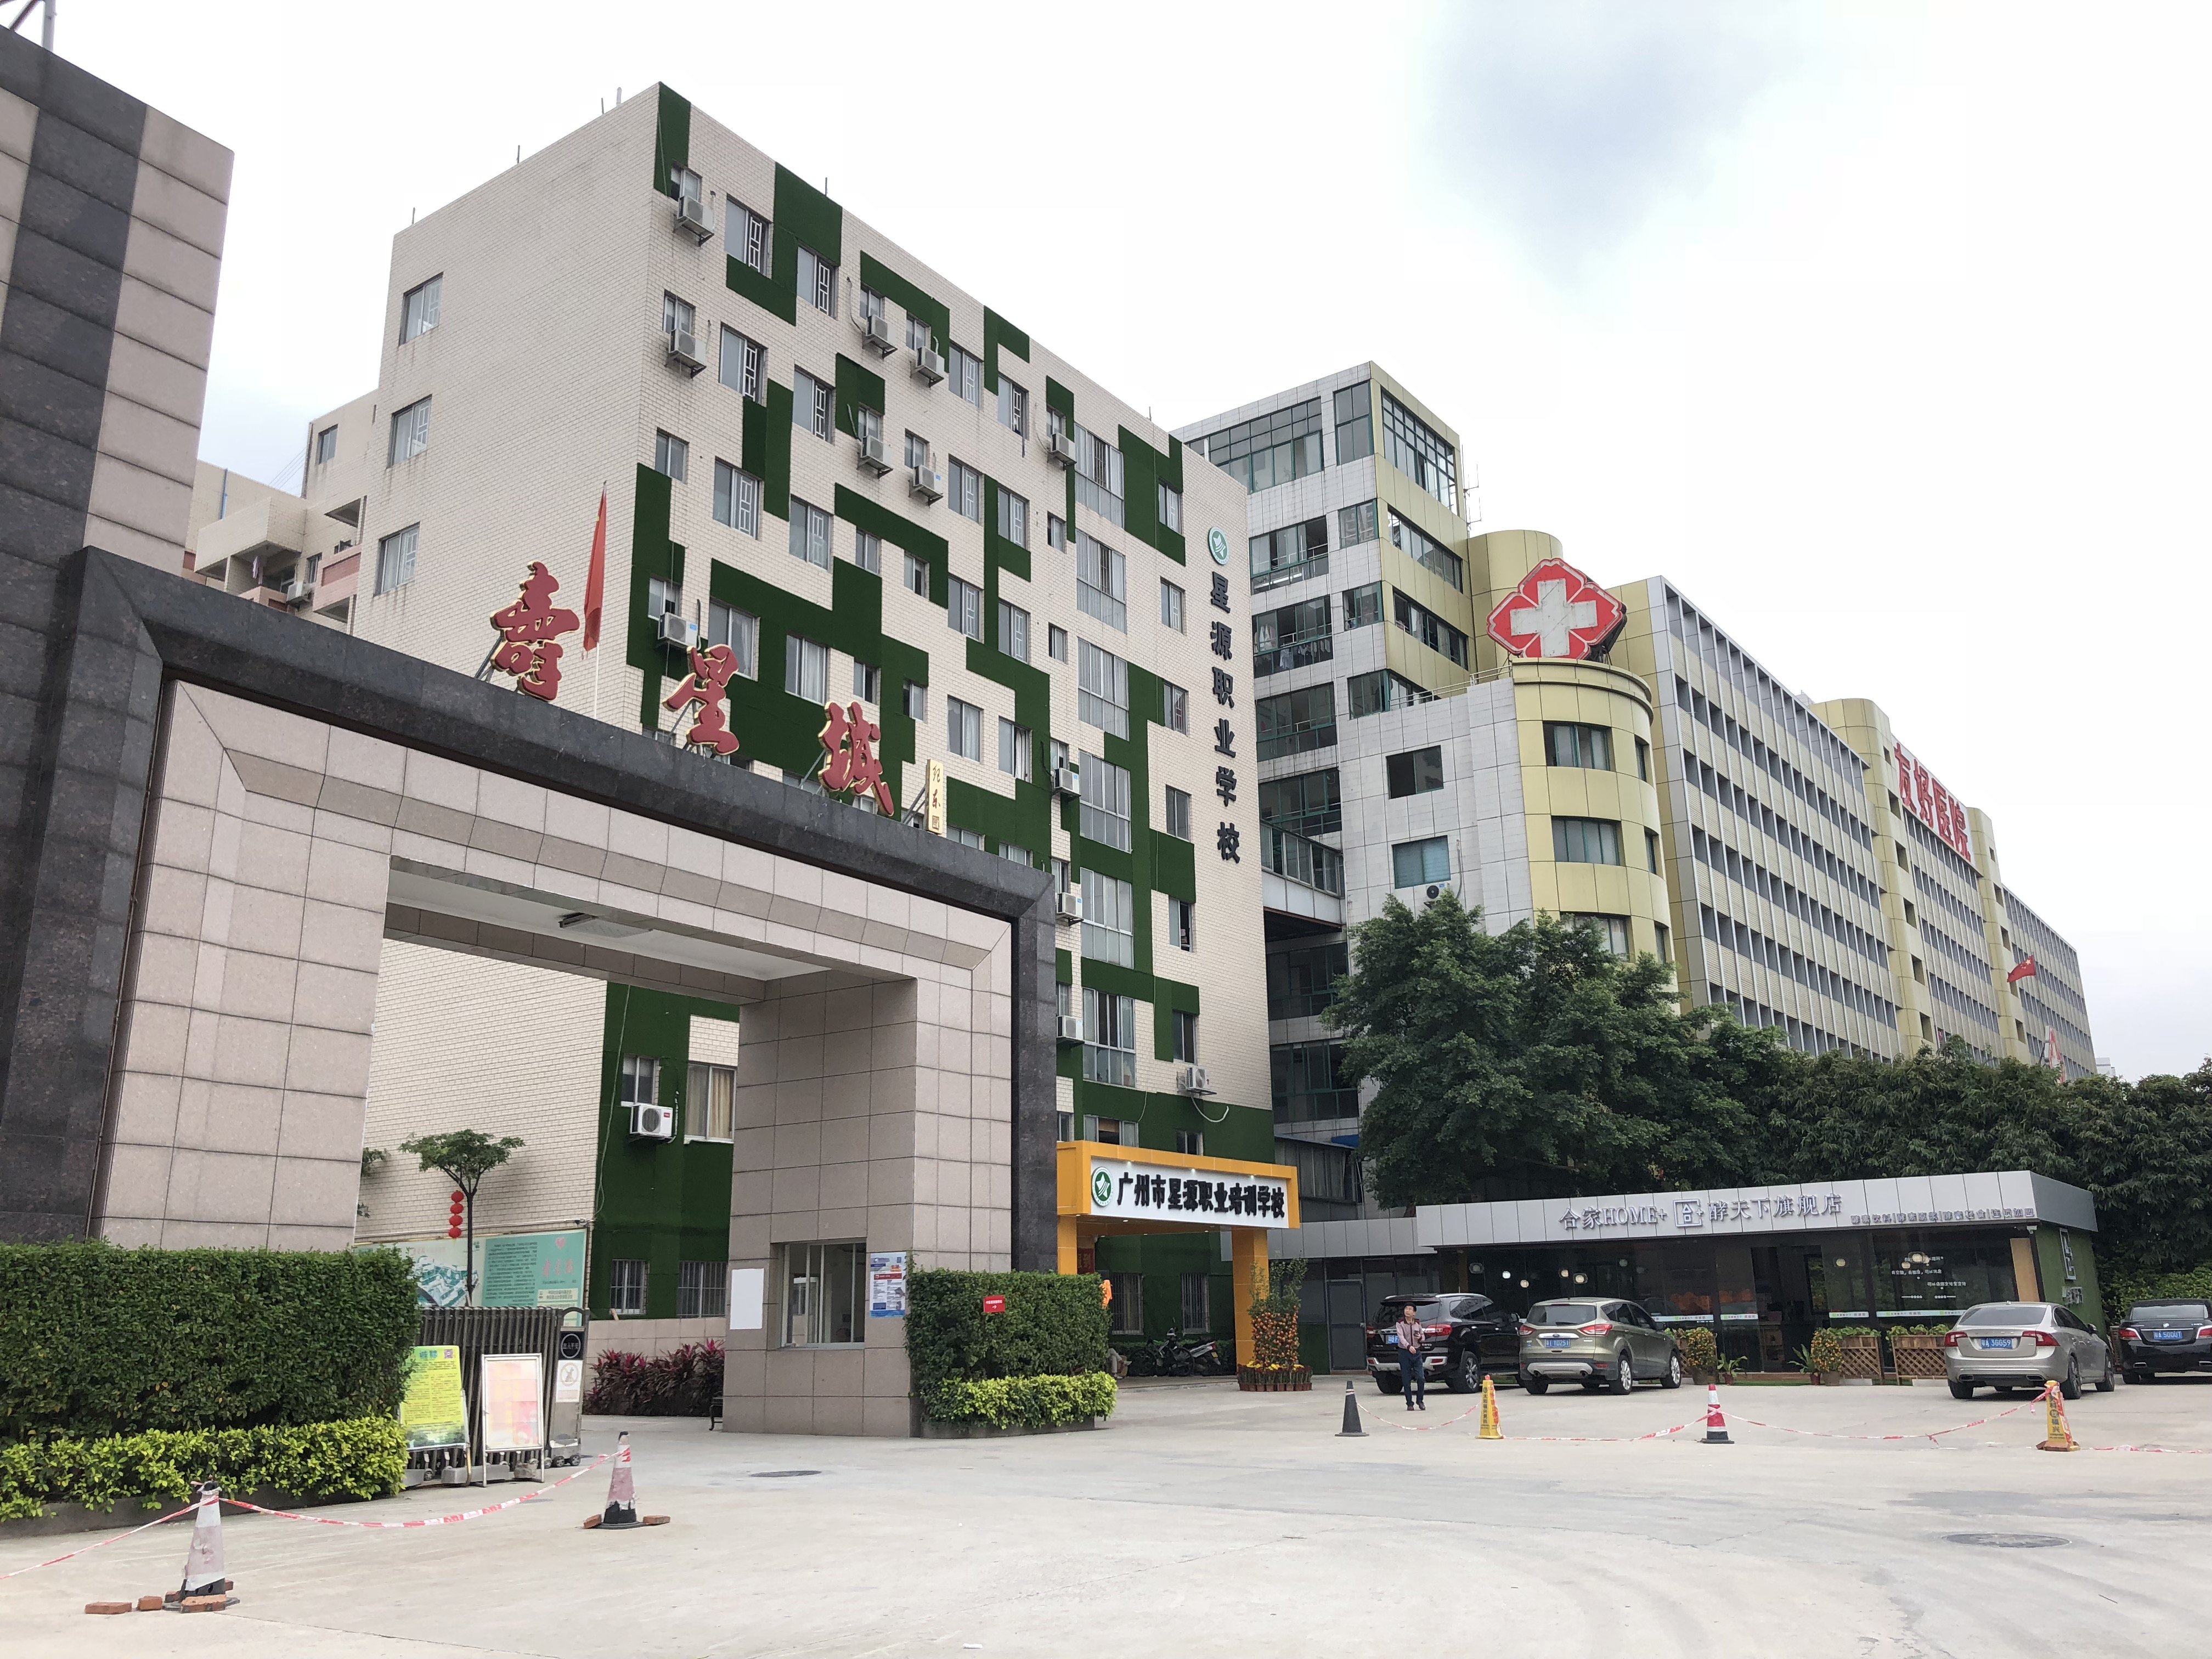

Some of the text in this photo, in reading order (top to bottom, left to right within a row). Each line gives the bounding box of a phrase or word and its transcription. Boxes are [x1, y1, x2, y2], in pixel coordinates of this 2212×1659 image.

[1210, 571, 1240, 864] 星源职业学校
[1893, 742, 1971, 862] 友好医院
[1117, 1172, 1285, 1218] 广州市星源职业培训学校
[1707, 1193, 1842, 1221] 酵天下旗舰店
